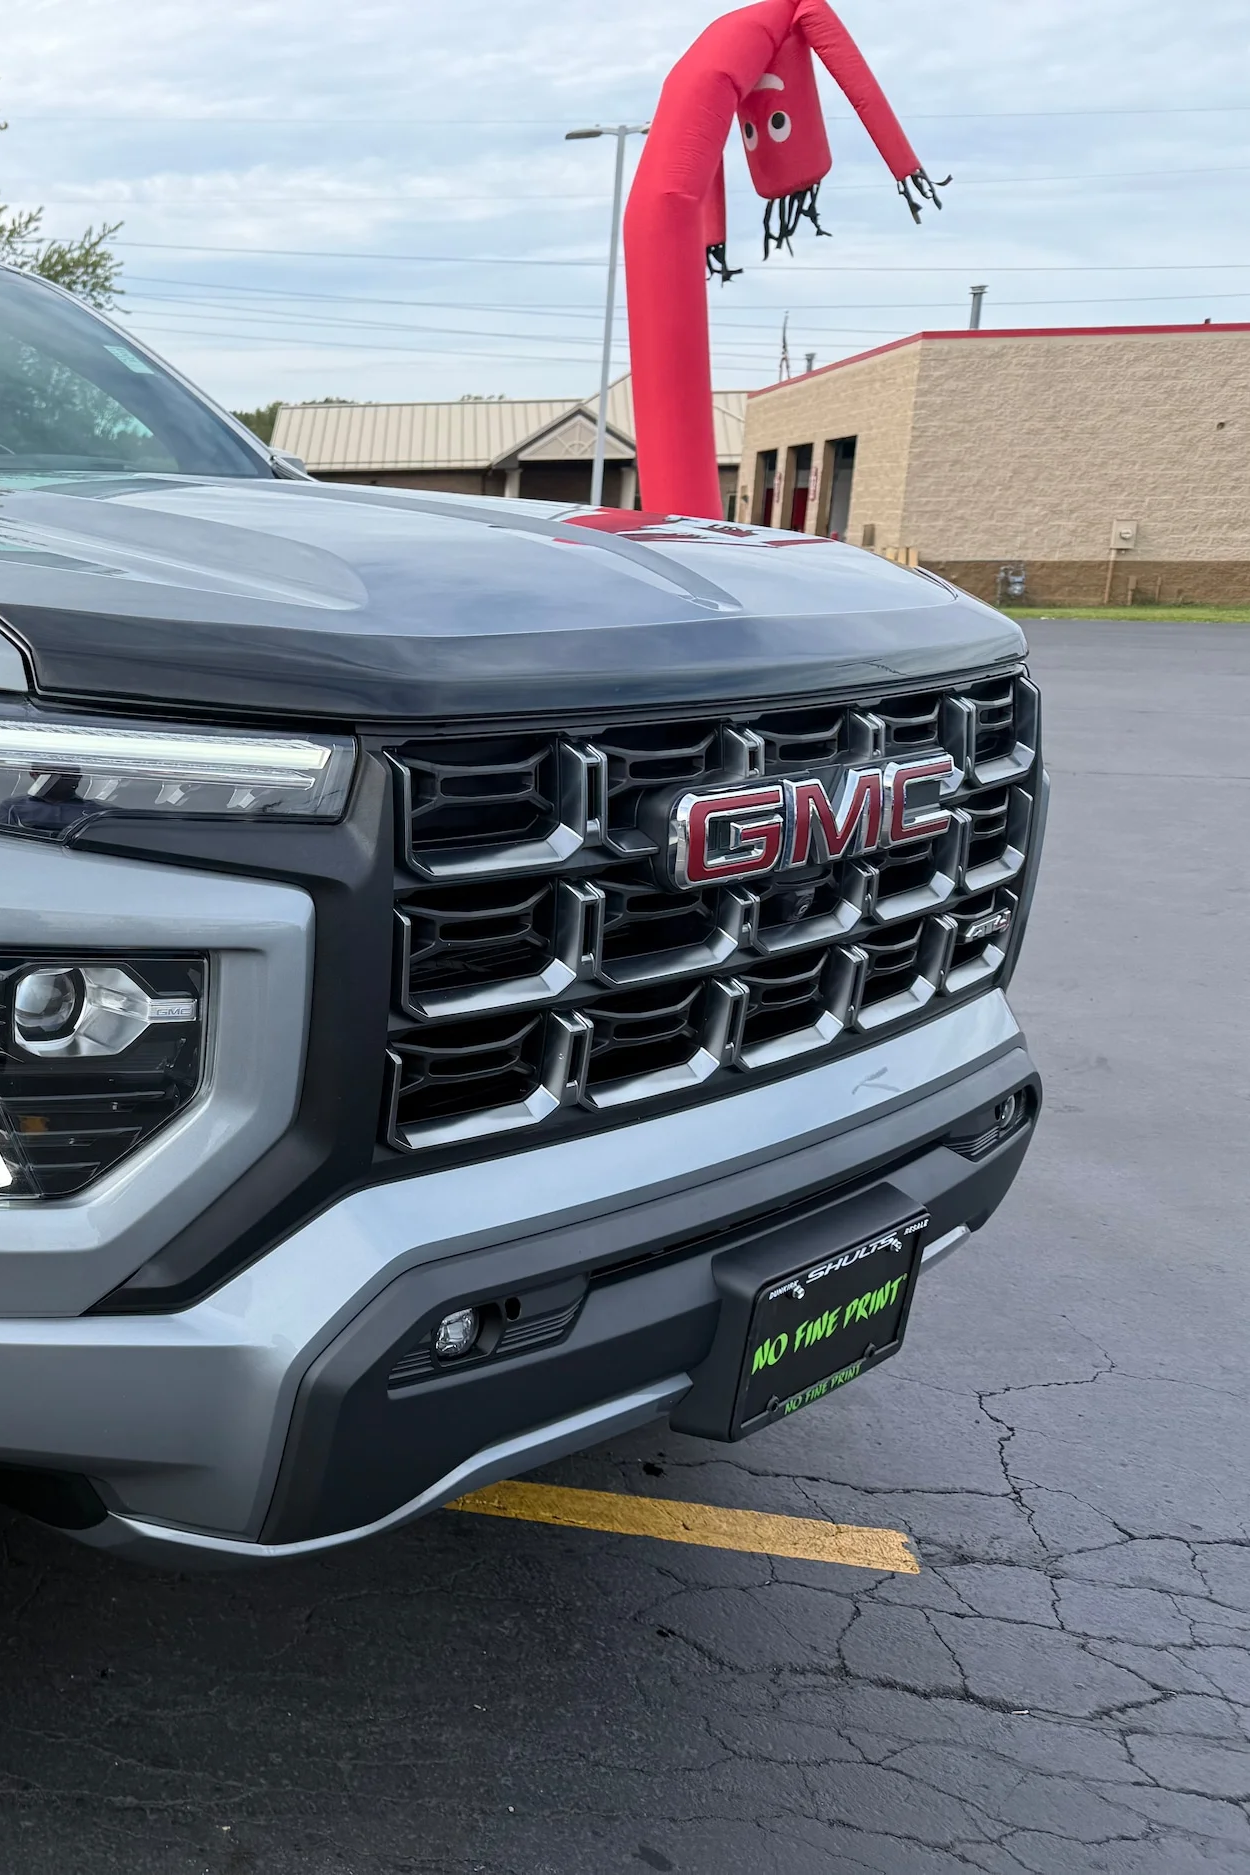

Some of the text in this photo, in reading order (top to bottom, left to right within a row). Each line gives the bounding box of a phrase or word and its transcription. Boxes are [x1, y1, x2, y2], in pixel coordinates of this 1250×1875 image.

[673, 754, 963, 890] GMC
[156, 1006, 192, 1016] GMC
[805, 1232, 898, 1285] SHULTS
[903, 1219, 930, 1236] RESALE
[751, 1332, 789, 1376] NO
[793, 1305, 843, 1353] FINE
[783, 1363, 863, 1416] NO FINE PRINT
